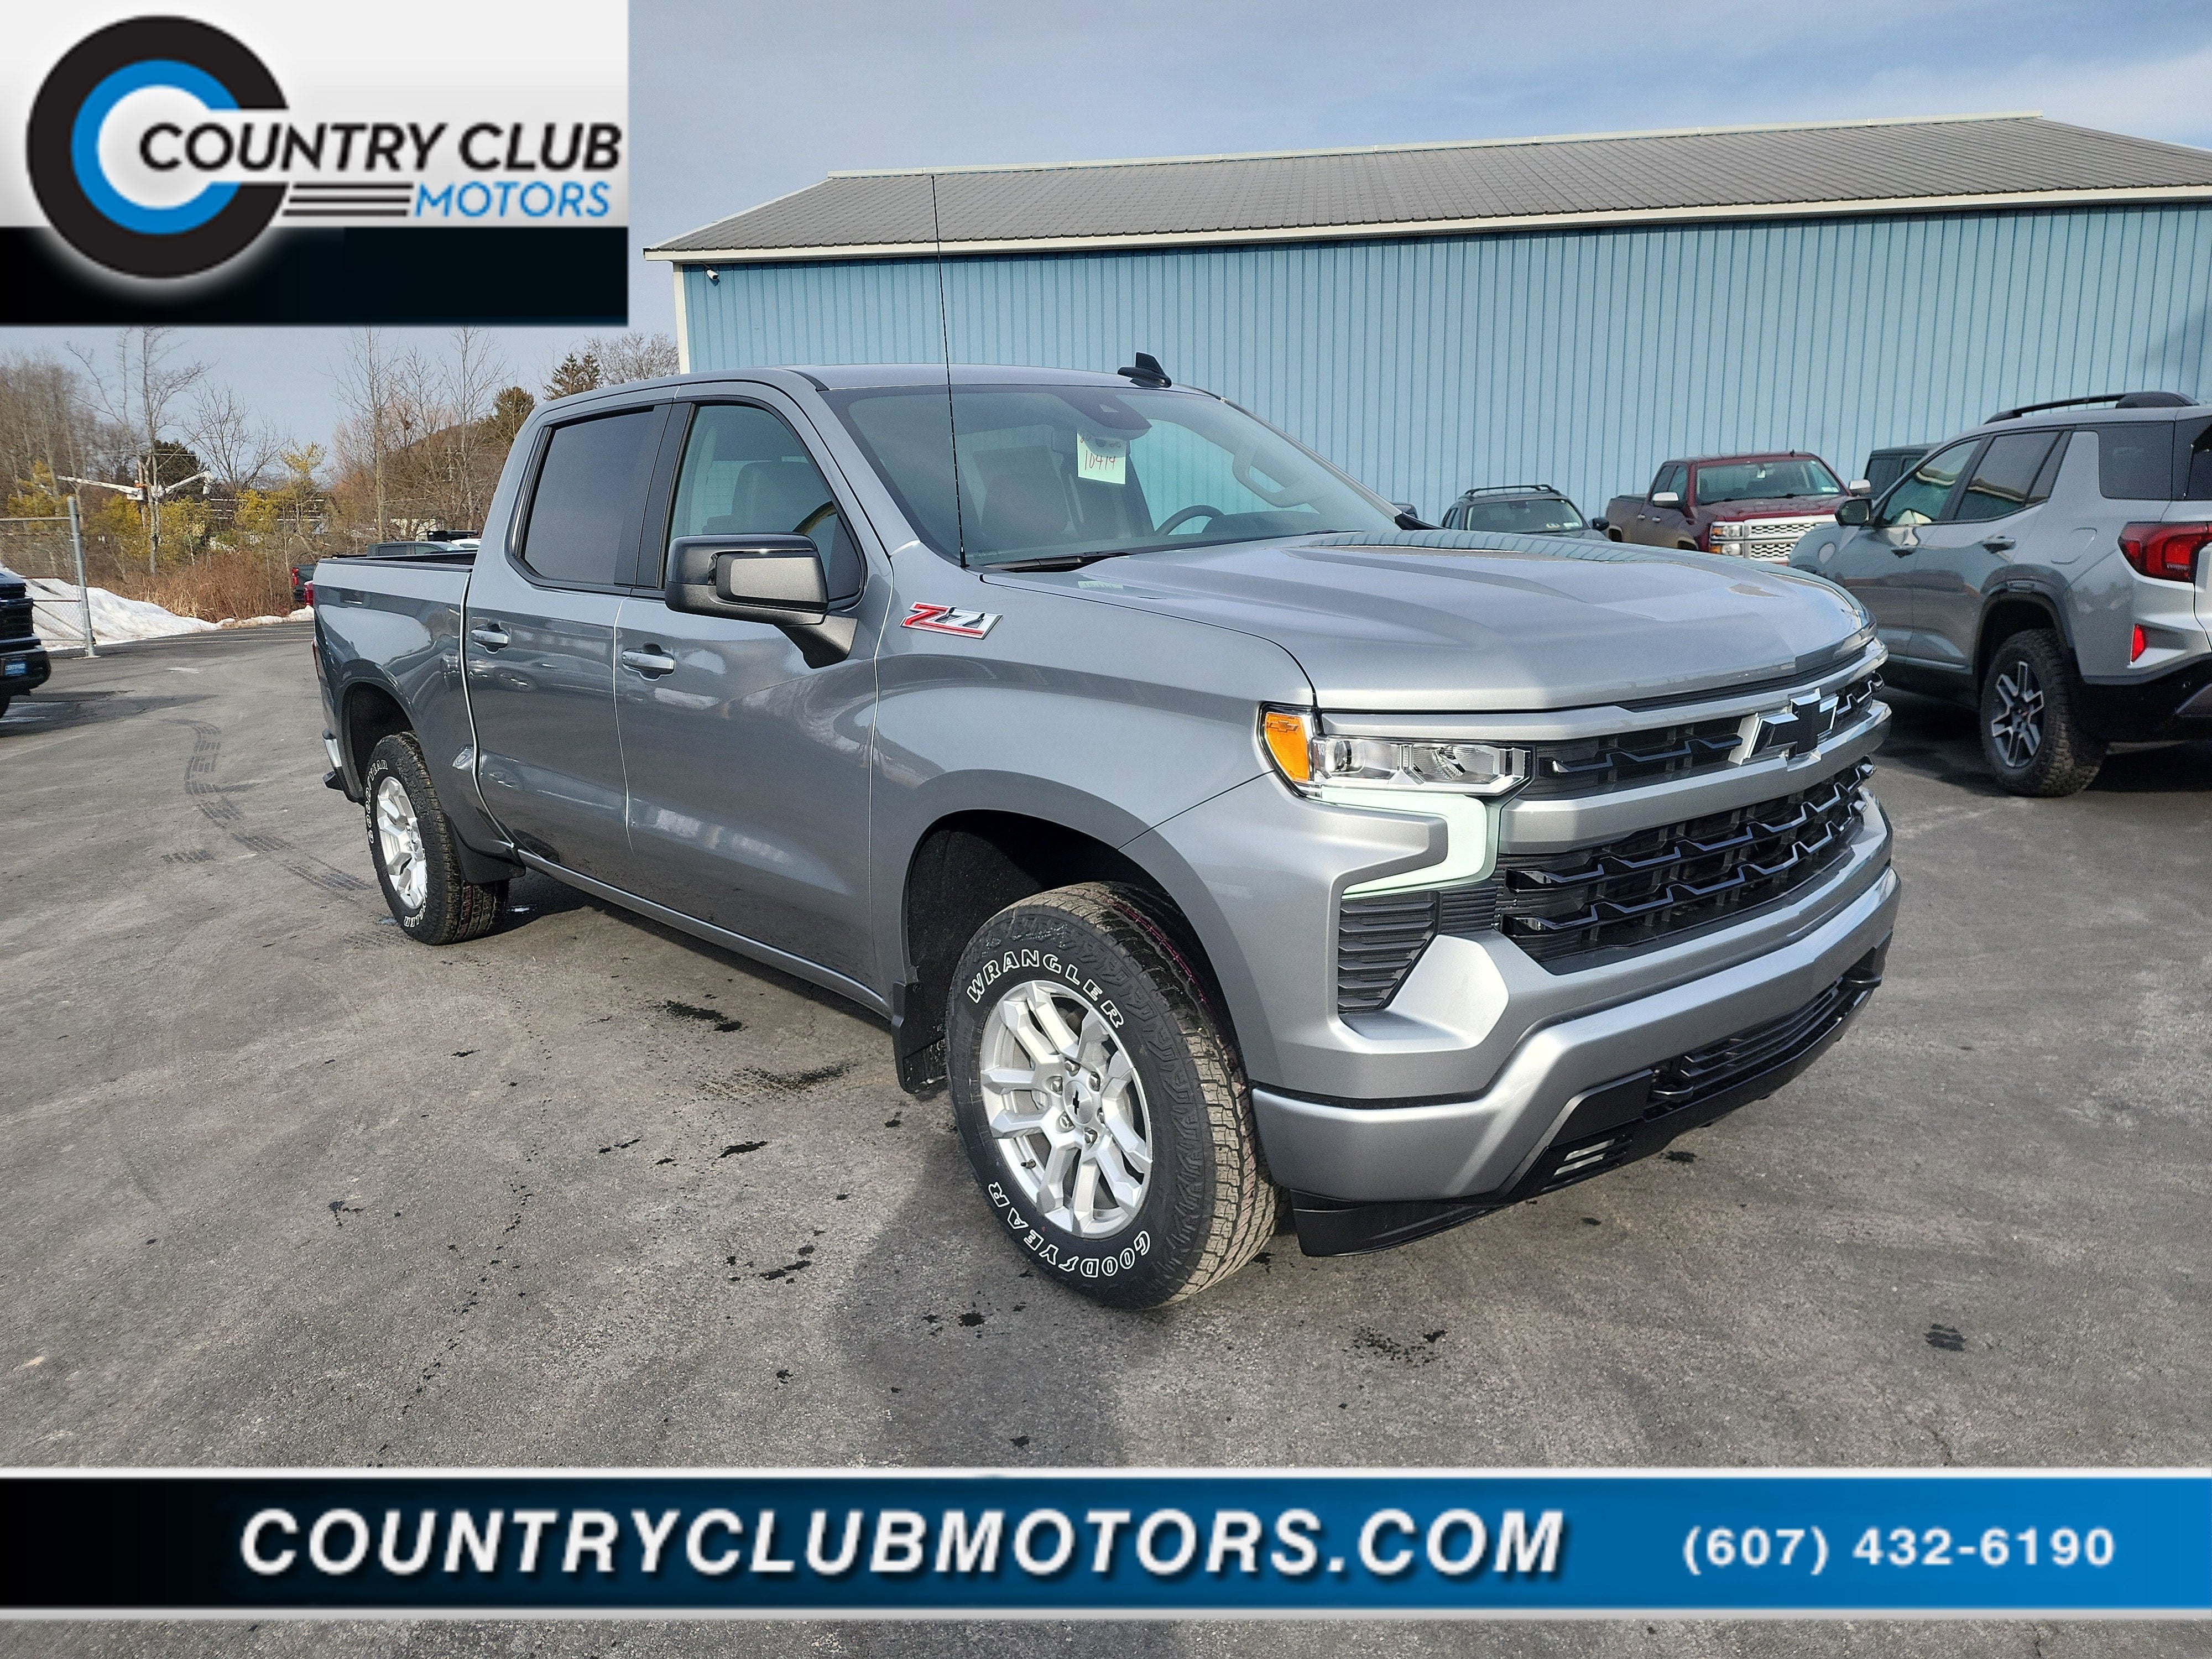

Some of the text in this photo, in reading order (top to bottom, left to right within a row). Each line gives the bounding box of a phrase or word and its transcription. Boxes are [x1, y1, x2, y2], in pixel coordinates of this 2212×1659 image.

[1084, 450, 1116, 471] 10414
[899, 601, 1003, 640] Z71
[365, 759, 388, 844] GOODYEAR
[967, 948, 1124, 1029] WRANGLER
[988, 1181, 1150, 1278] GOODYEAR
